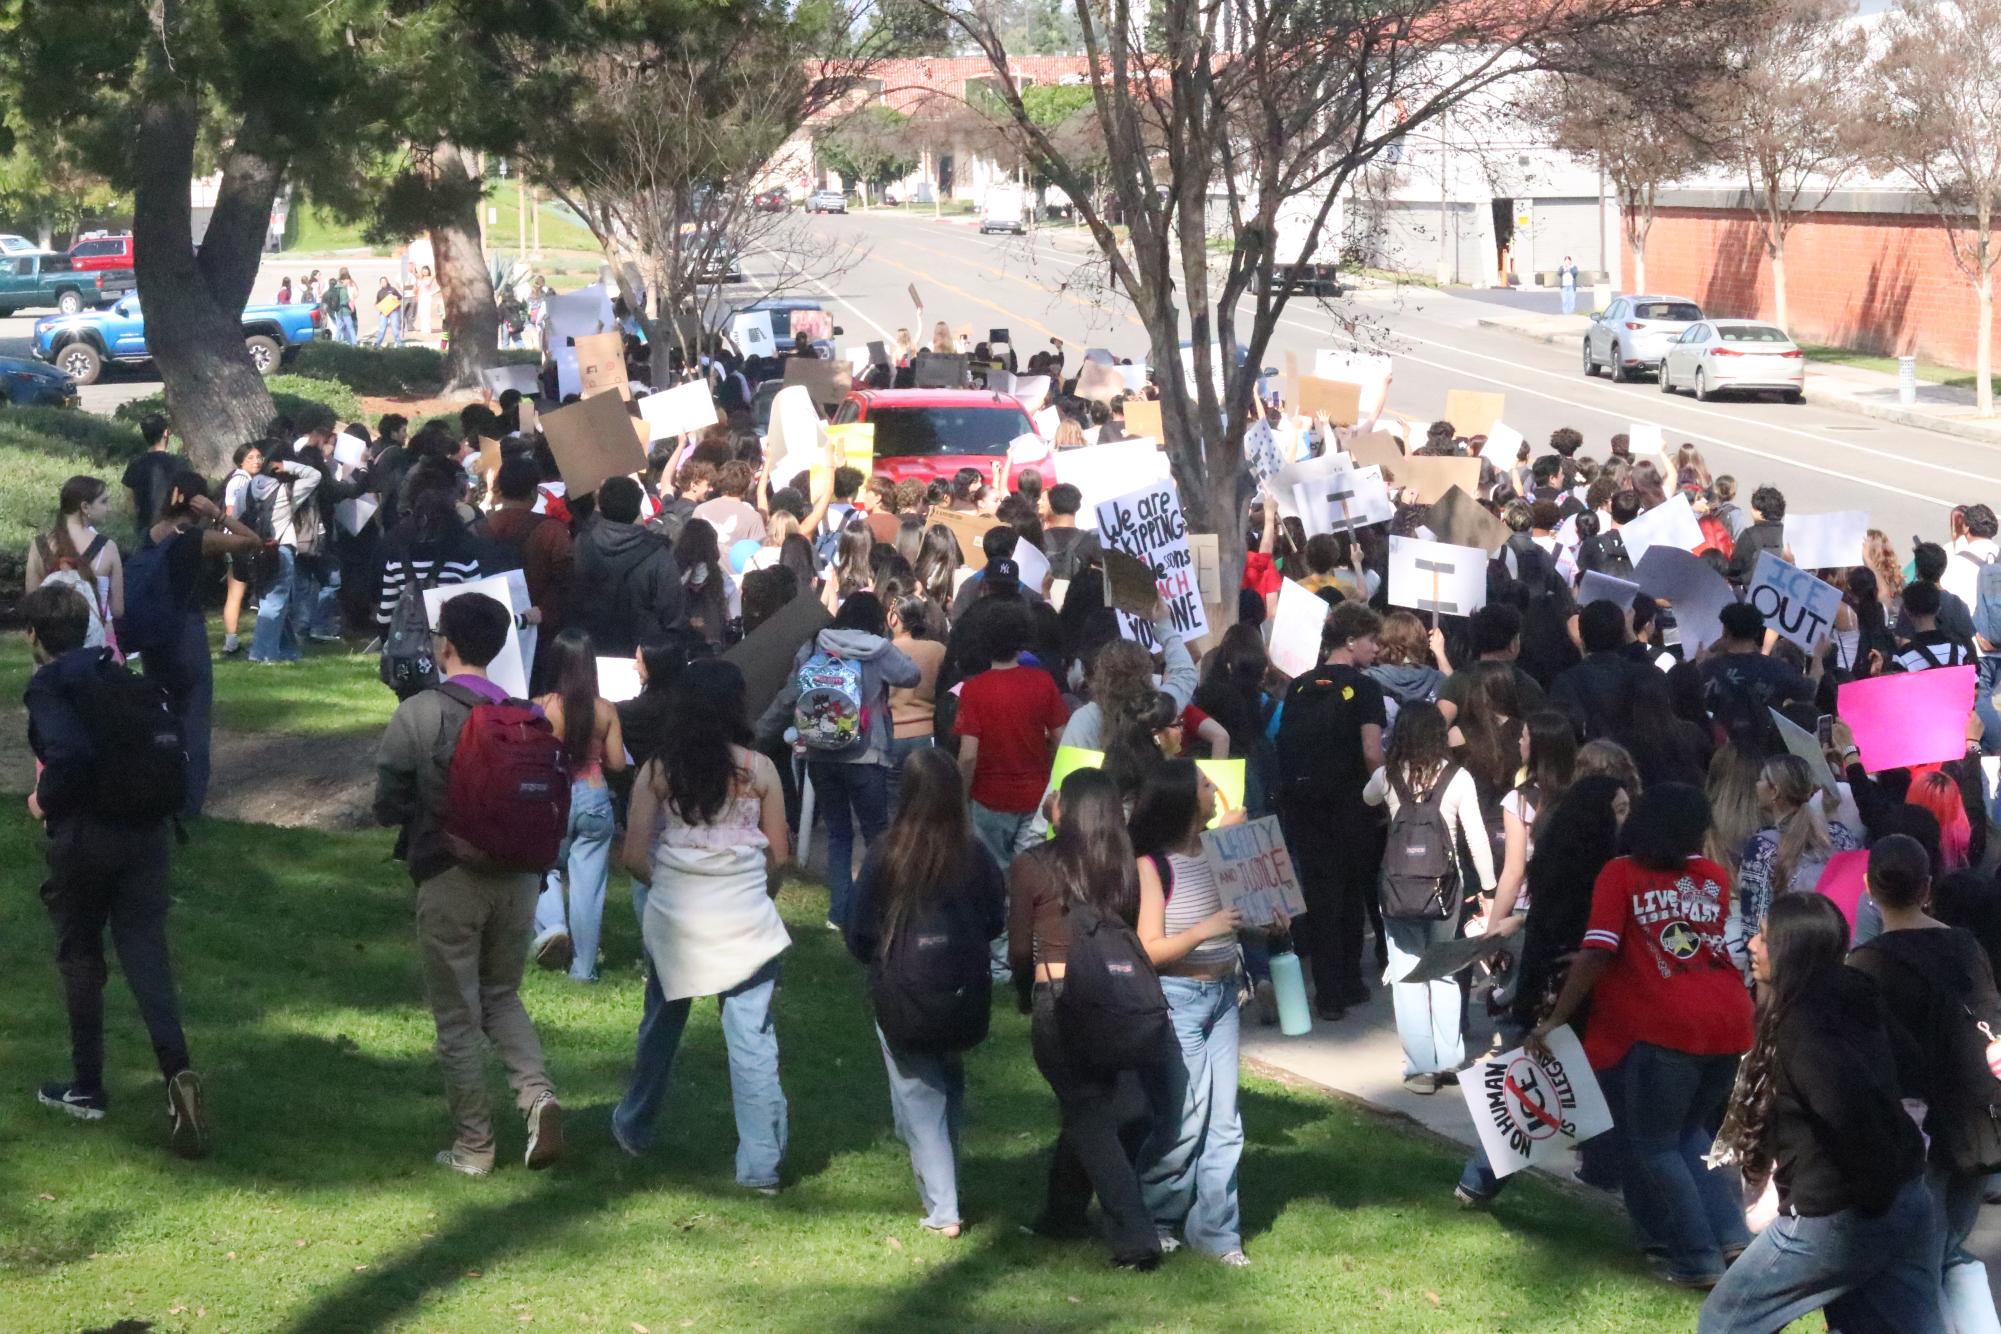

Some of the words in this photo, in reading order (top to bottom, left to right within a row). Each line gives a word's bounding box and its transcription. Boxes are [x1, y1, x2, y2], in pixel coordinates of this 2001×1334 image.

[1097, 501, 1135, 541] We
[1138, 491, 1170, 520] are
[1154, 570, 1190, 601] ACH
[1767, 559, 1828, 612] ICE
[1752, 585, 1828, 644] OUT
[1632, 890, 1679, 915] LIVE
[1681, 901, 1720, 923] FAST
[1484, 1063, 1514, 1136] HUMAN
[1509, 1067, 1553, 1132] ICE
[1539, 1055, 1577, 1109] ILLEGA
[1510, 1129, 1532, 1159] NO
